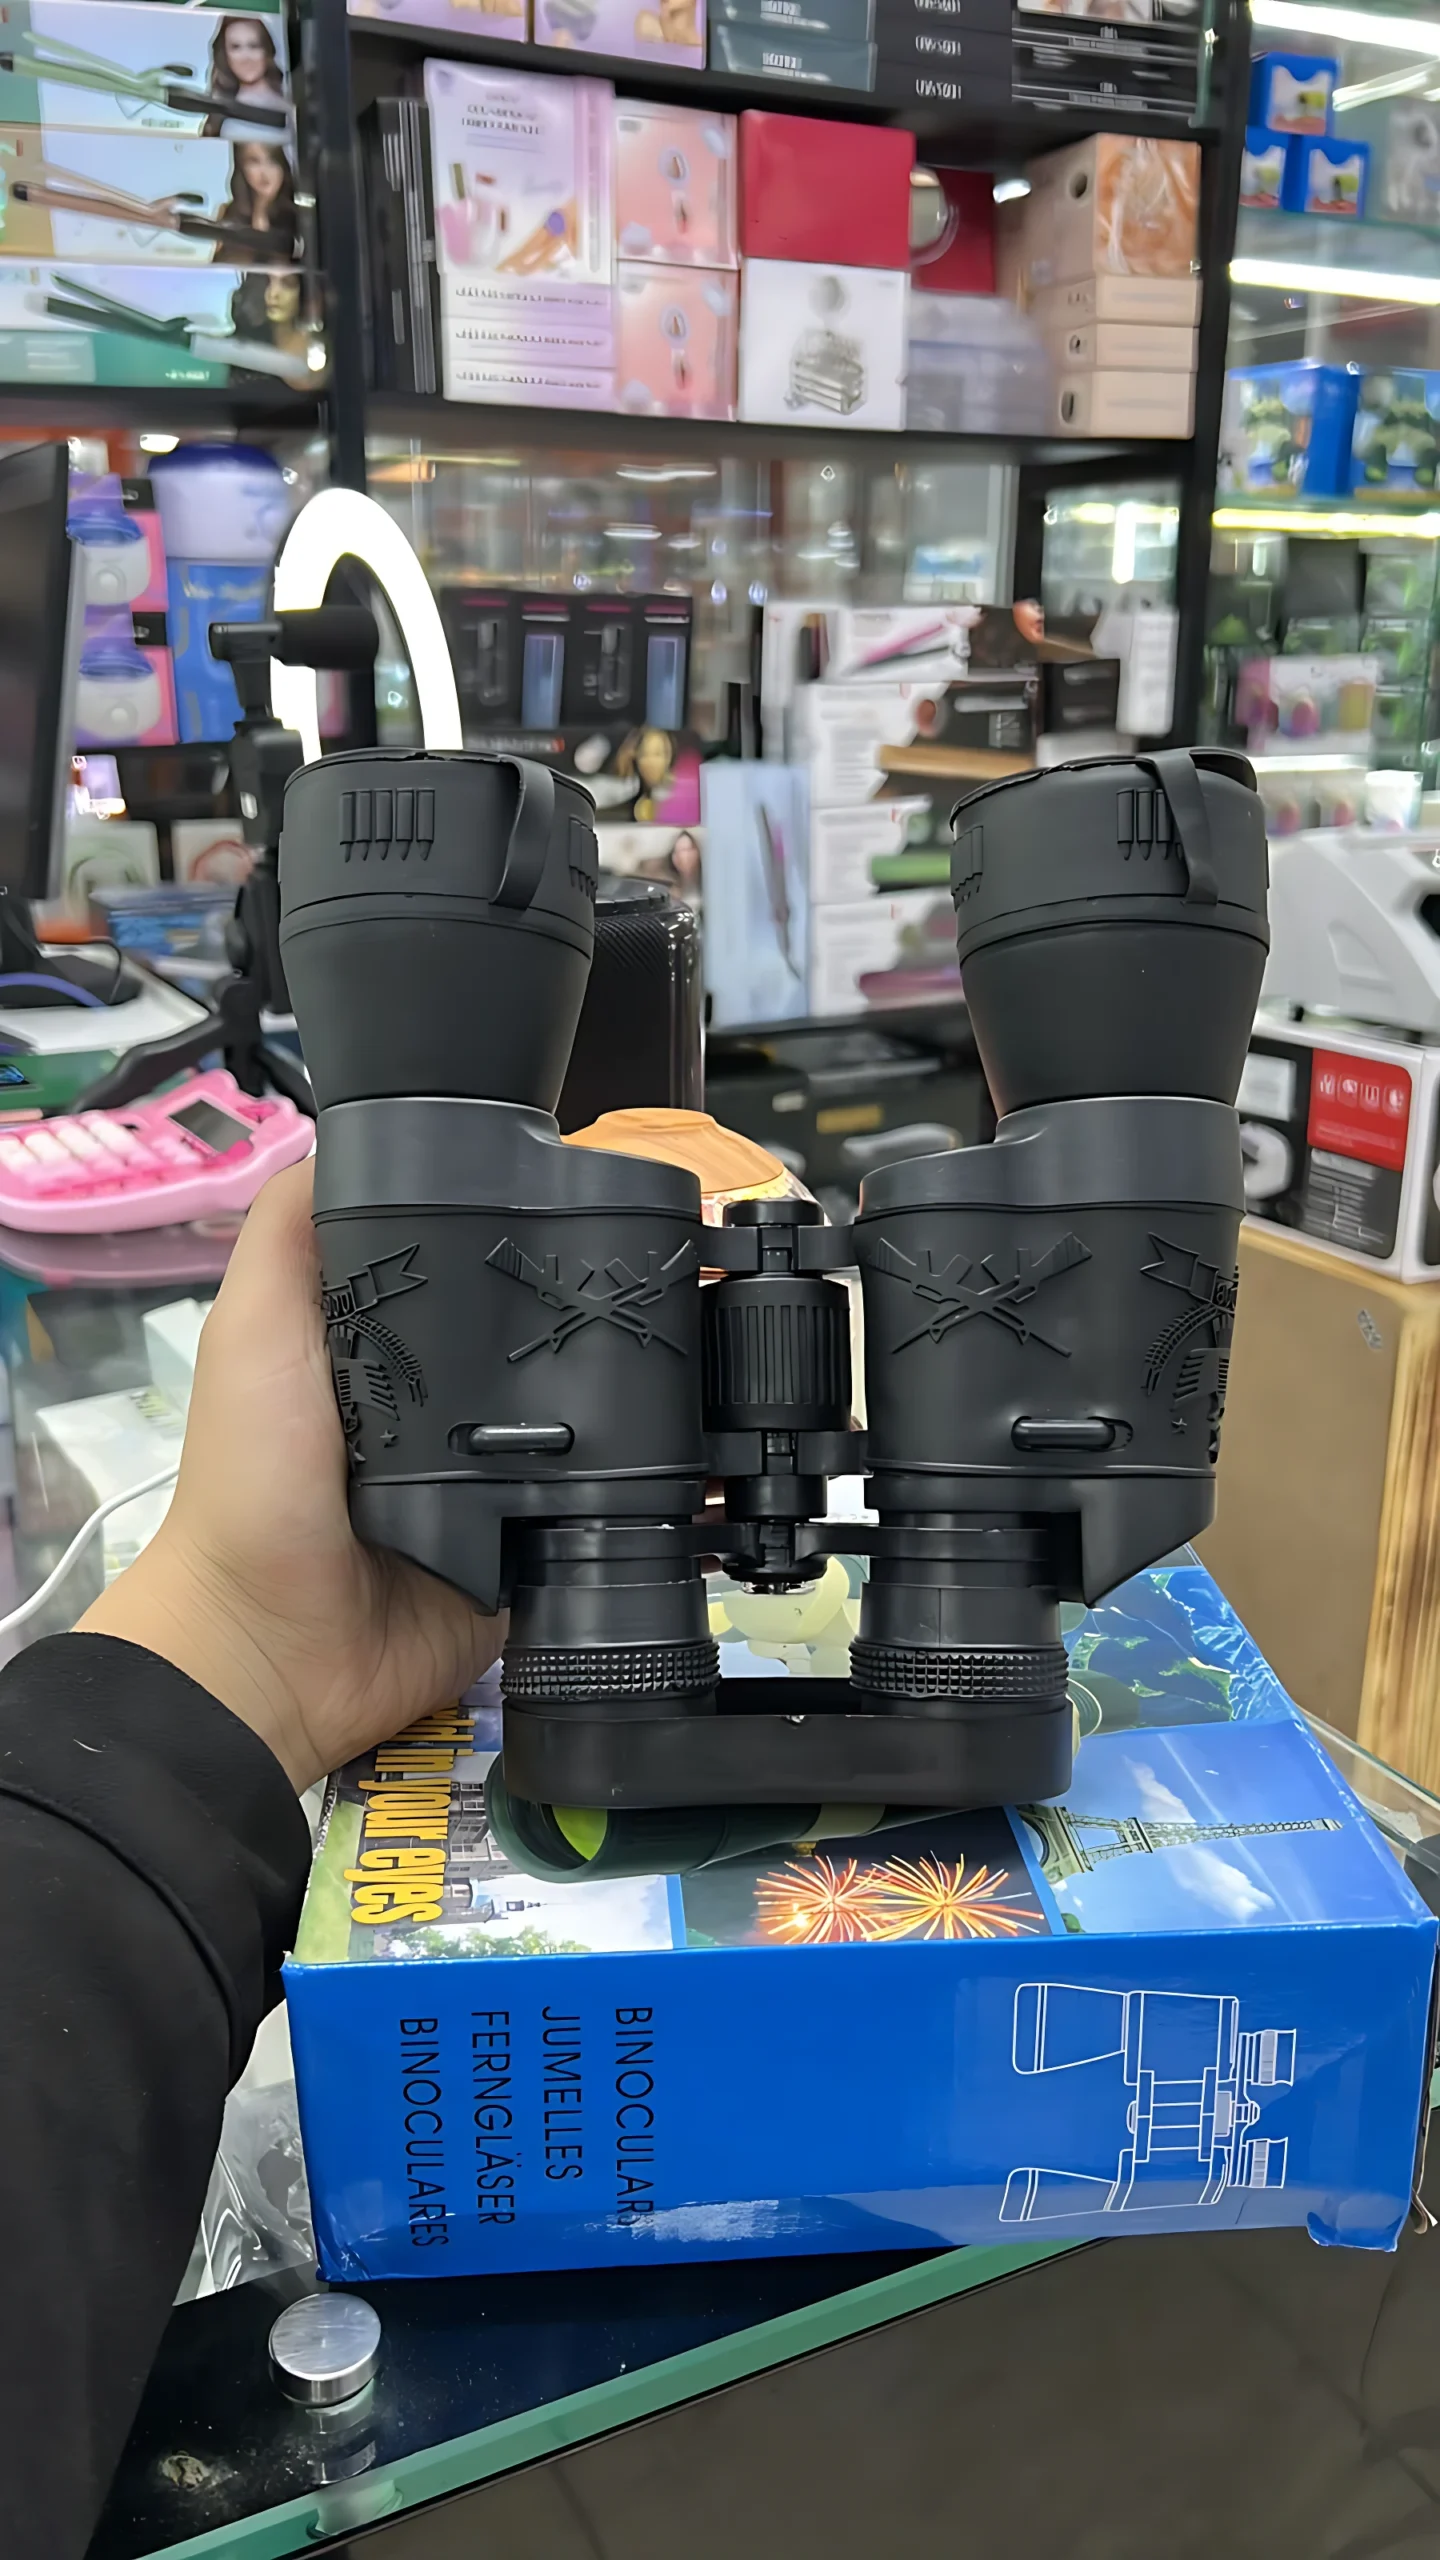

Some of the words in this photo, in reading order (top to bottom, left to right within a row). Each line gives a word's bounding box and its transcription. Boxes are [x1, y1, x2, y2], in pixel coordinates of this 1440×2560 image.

[357, 1778, 452, 1840] your
[375, 1748, 474, 1772] in
[343, 1847, 447, 1925] eyes
[400, 2018, 449, 2247] BINOCULARES
[471, 2011, 522, 2225] FERNGLÄSER
[542, 2006, 583, 2180] JUMELLES
